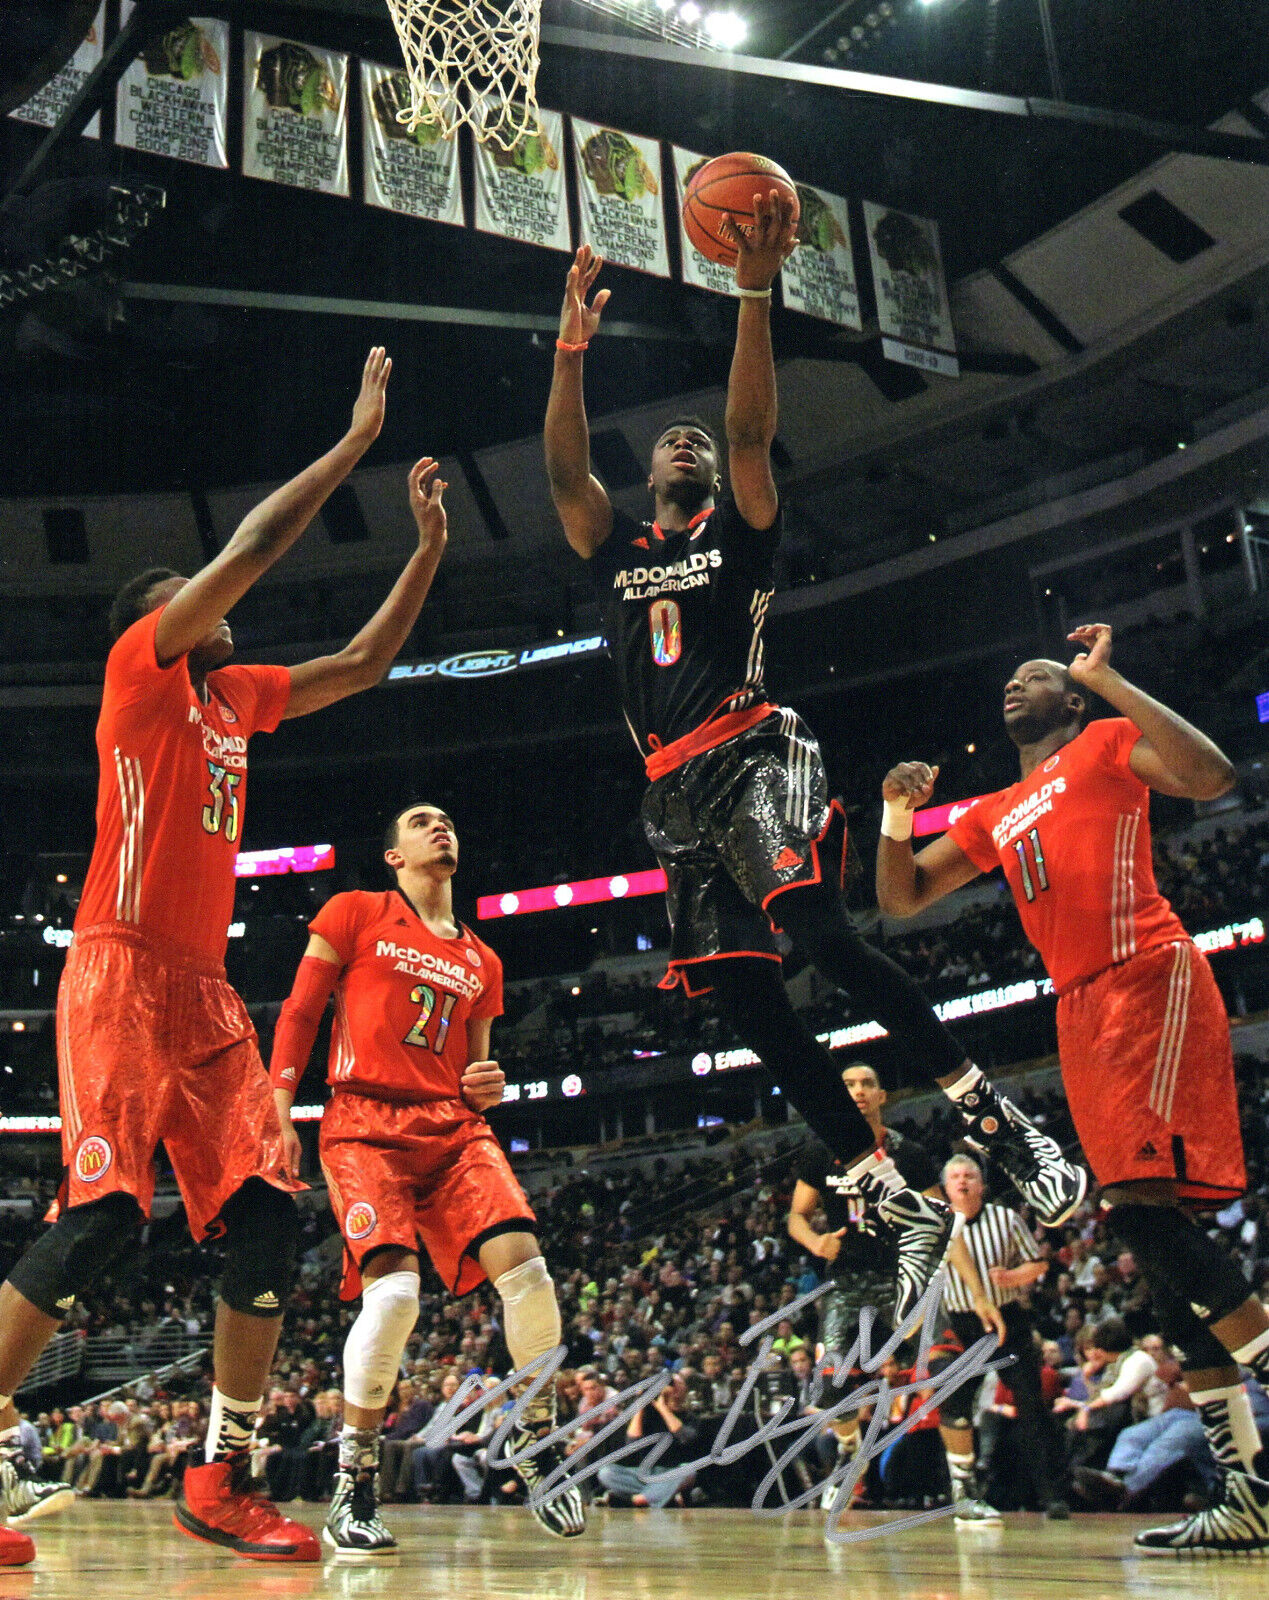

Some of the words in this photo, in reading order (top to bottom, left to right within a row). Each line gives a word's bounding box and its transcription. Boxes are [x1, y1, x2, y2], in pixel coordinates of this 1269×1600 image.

[129, 108, 214, 140] CONFERENCE
[141, 100, 205, 125] WESTERN
[498, 167, 544, 191] CHICAGO
[492, 188, 552, 214] CAMPBELL
[599, 194, 644, 217] CHICAGO
[492, 210, 555, 236] CHAMPIONS
[504, 225, 546, 245] 1971-72
[594, 214, 653, 240] CAMPBELL
[590, 223, 659, 251] CONFERENCE
[595, 236, 656, 262] CHAMPIONS
[606, 249, 647, 271] 1970-71
[648, 599, 682, 667] 0
[388, 663, 437, 680] BUD
[452, 654, 516, 672] LIGHT
[202, 758, 241, 843] 35
[1011, 827, 1050, 903] 11
[402, 984, 460, 1057] 21
